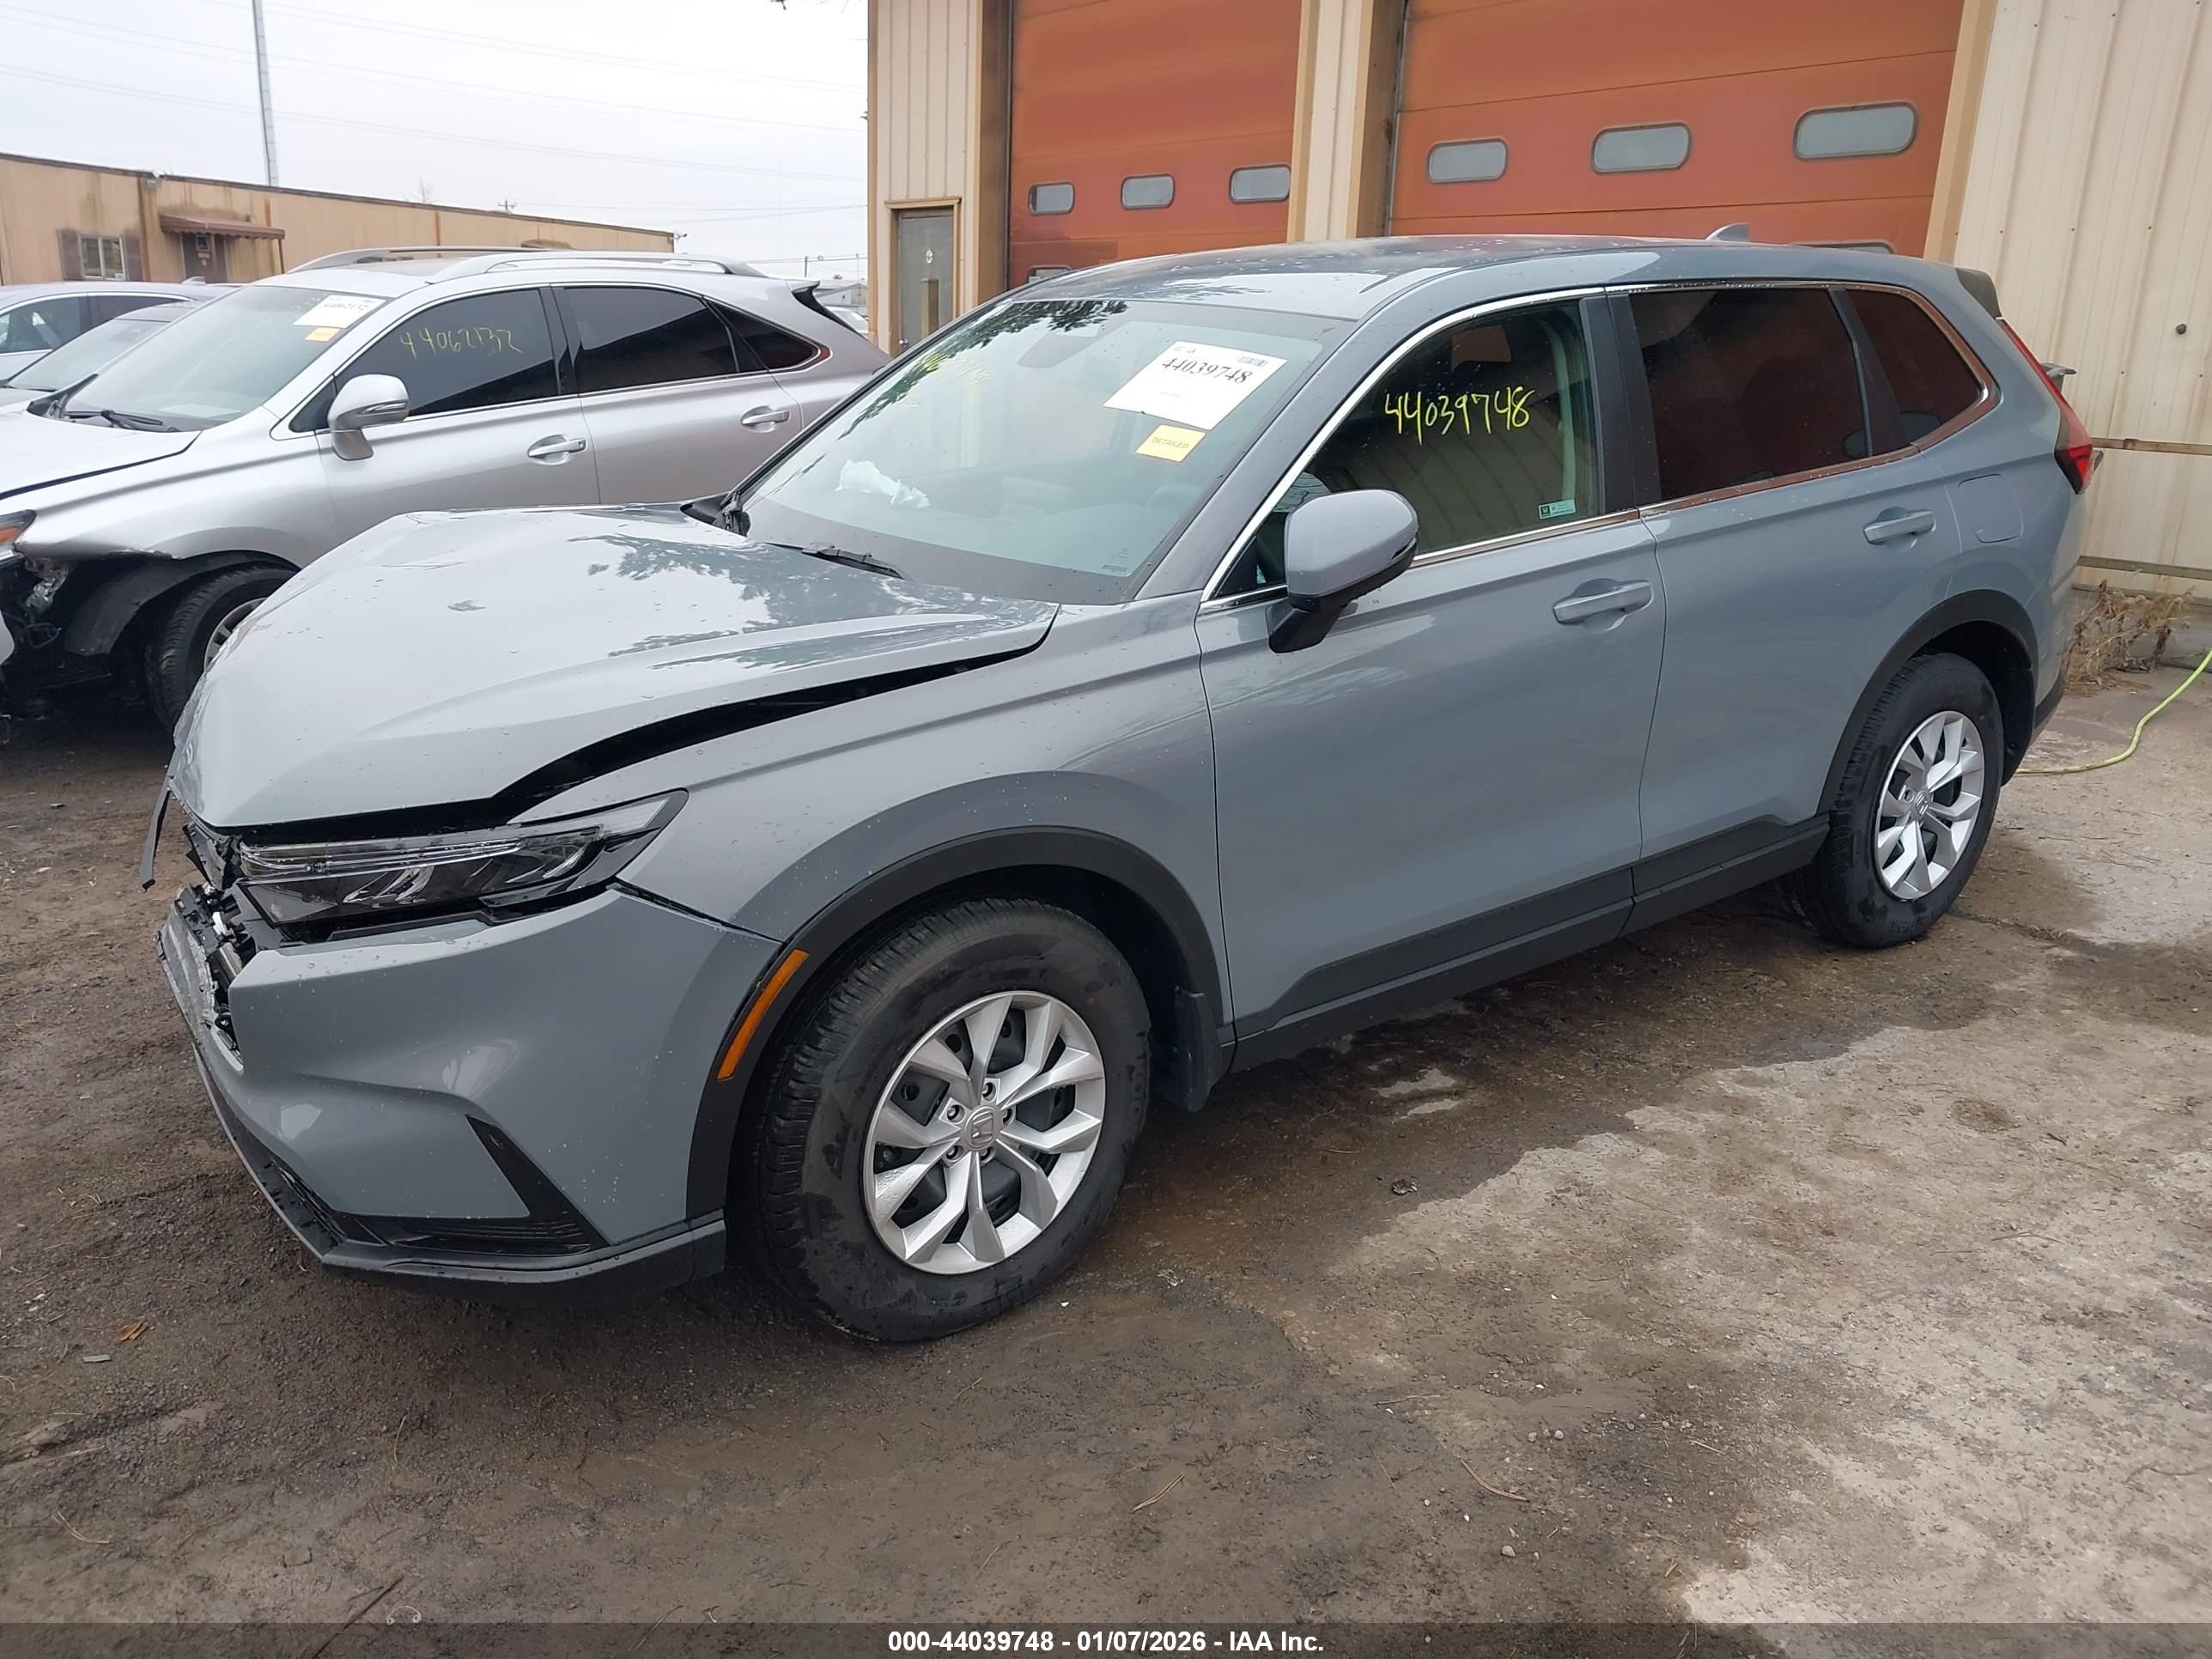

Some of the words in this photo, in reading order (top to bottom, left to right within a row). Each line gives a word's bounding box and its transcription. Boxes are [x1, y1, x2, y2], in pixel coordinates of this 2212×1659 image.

[399, 327, 523, 361] 44062132
[1162, 357, 1253, 384] 44039748
[1384, 386, 1535, 446] 44039748
[1151, 437, 1189, 449] DETAILED
